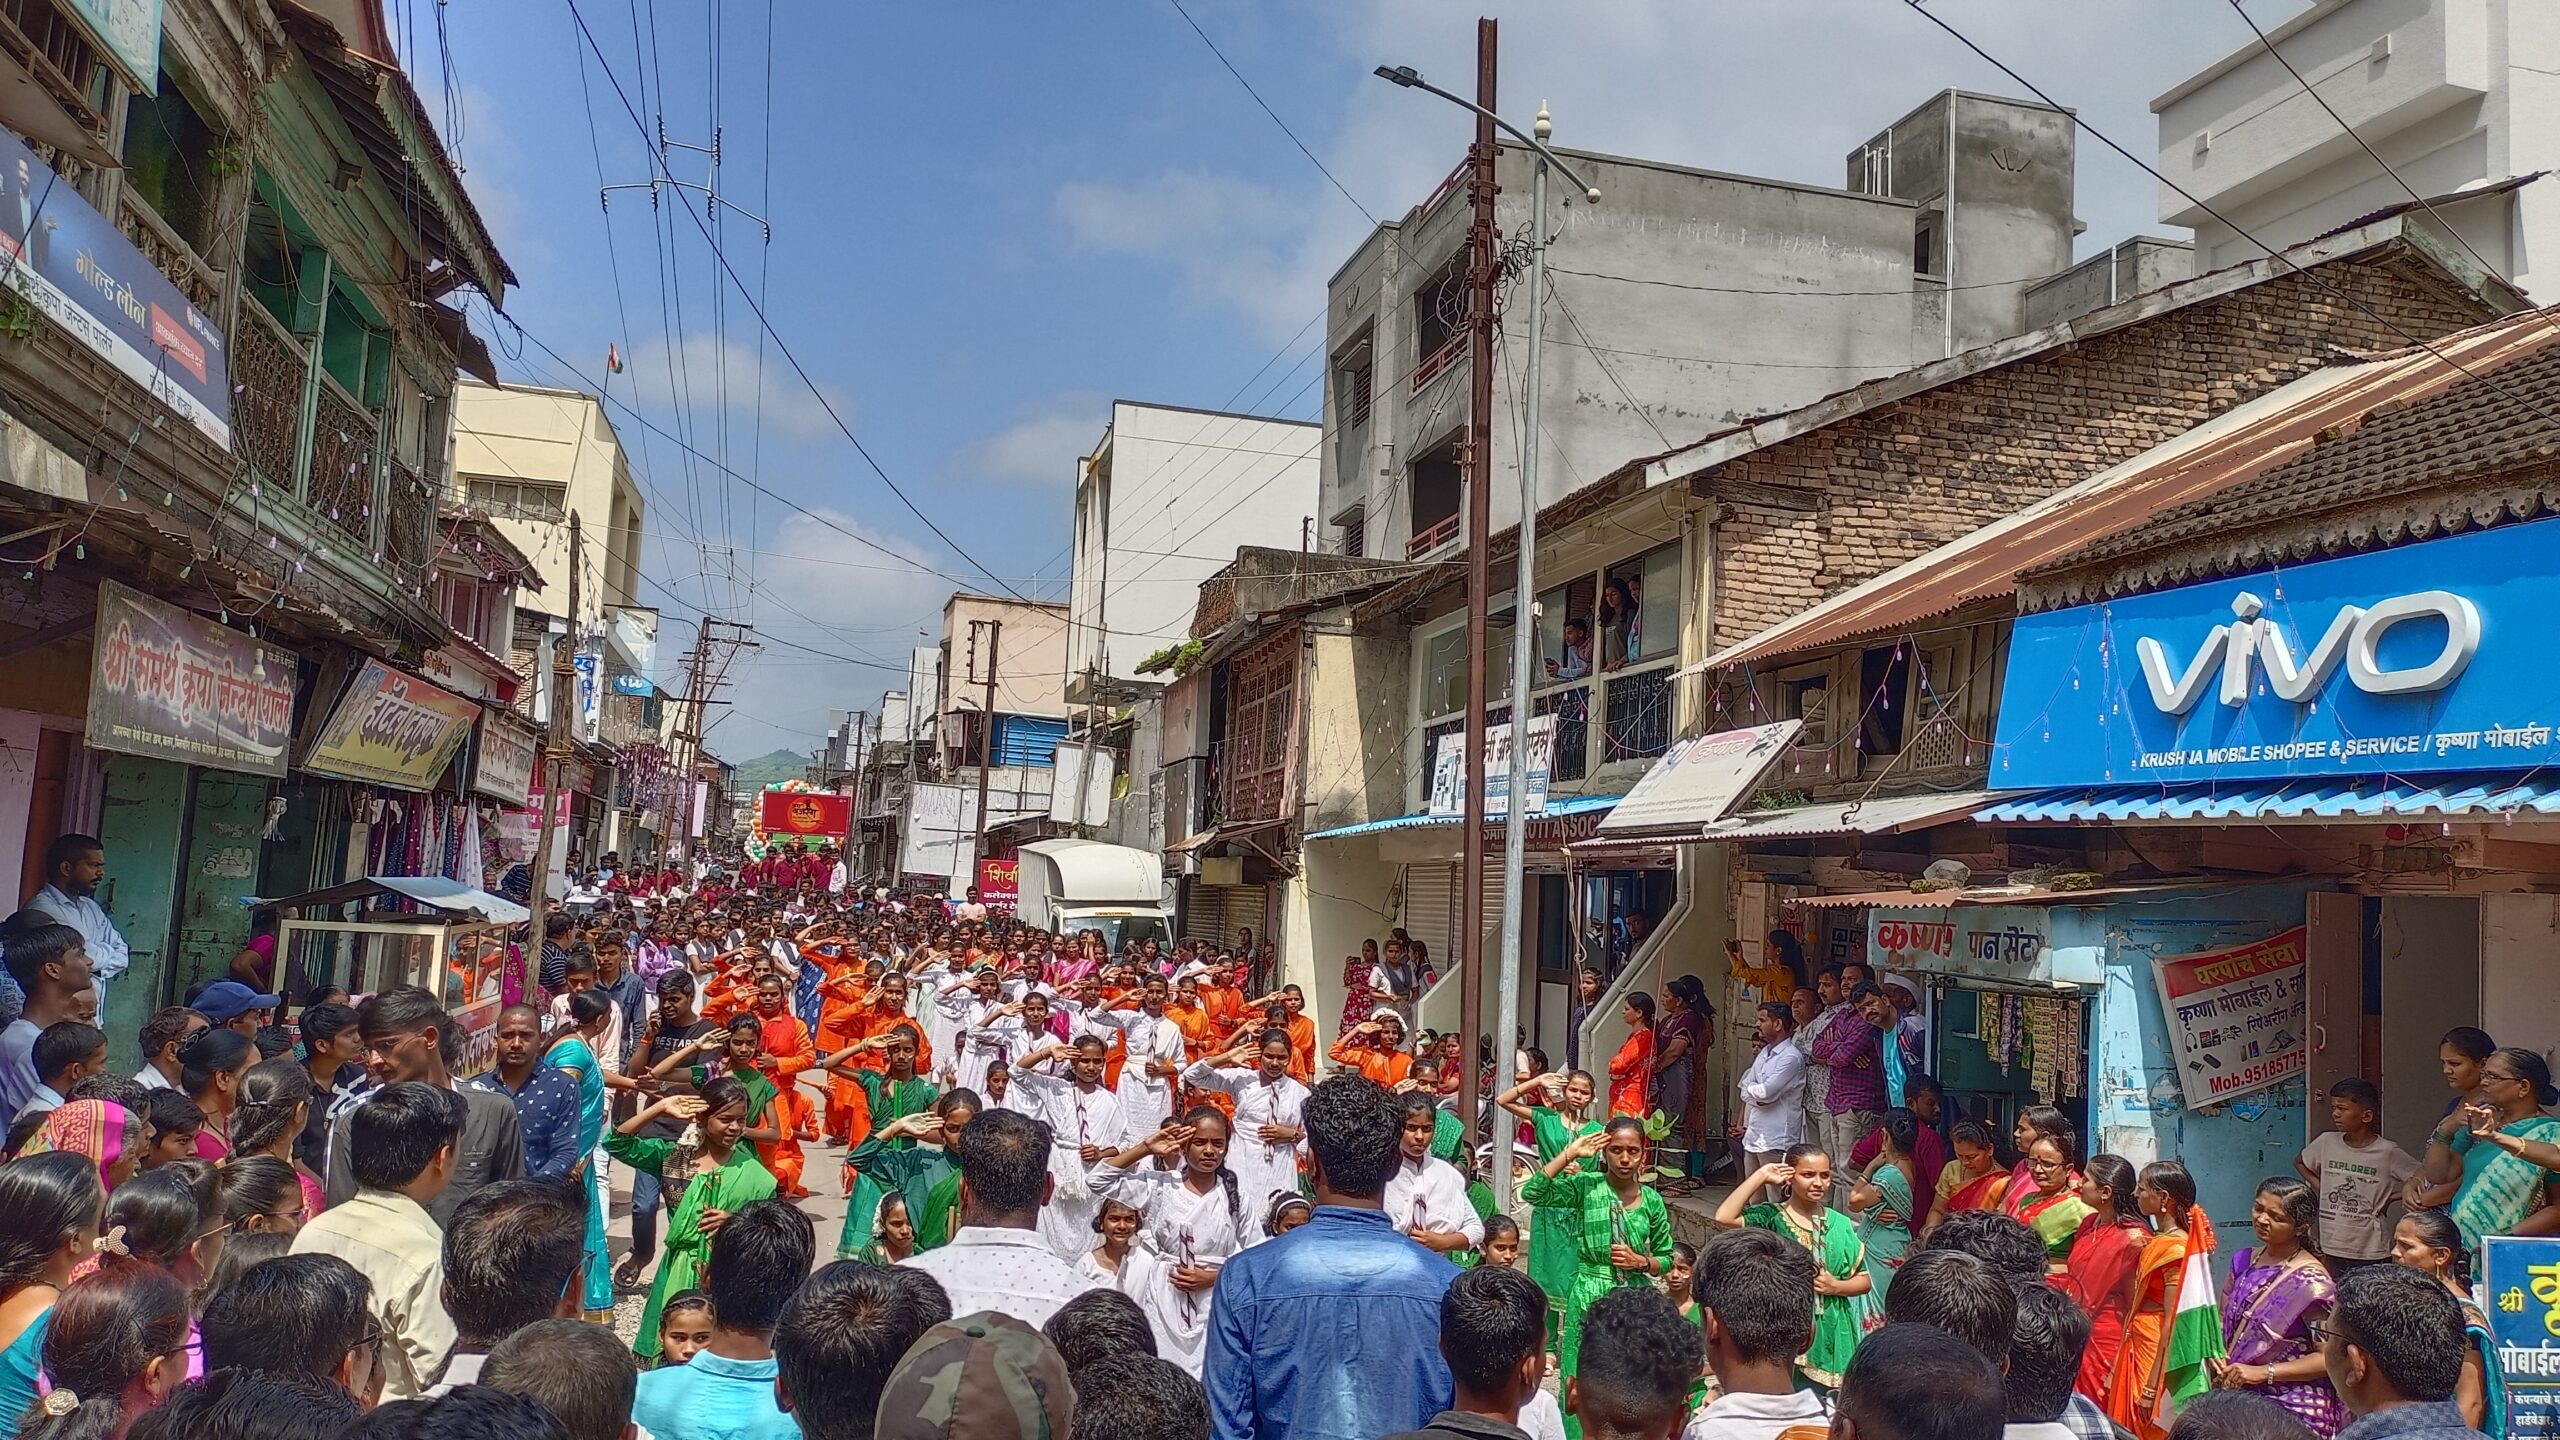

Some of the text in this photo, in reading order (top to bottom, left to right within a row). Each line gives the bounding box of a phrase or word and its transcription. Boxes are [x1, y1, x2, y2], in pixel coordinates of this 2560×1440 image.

[75, 248, 146, 329] गोल्ड लोन
[2136, 590, 2482, 716] vivo
[105, 622, 131, 688] श्री
[134, 641, 181, 701] समर्थ
[181, 661, 215, 723] कृपा
[261, 676, 293, 737] पार्लर
[360, 677, 413, 737] हॉटेल
[2206, 746, 2261, 764] MOBILE
[2263, 741, 2326, 761] SHOPEE
[2329, 740, 2341, 757] &
[2345, 735, 2420, 756] SERVICE
[2435, 731, 2480, 757] कृष्णा
[2484, 722, 2551, 750] मोबाईल
[1878, 920, 1956, 964] कृष्णा
[1968, 931, 2001, 961] पान
[2193, 954, 2256, 985] घरपोच
[2256, 942, 2300, 969] सेवा
[2177, 999, 2218, 1031] कृष्णा
[2217, 981, 2272, 1014] मोबाईल
[2275, 978, 2288, 999] &
[2329, 1160, 2377, 1176] EXPLORER
[2498, 1286, 2525, 1313] श्री
